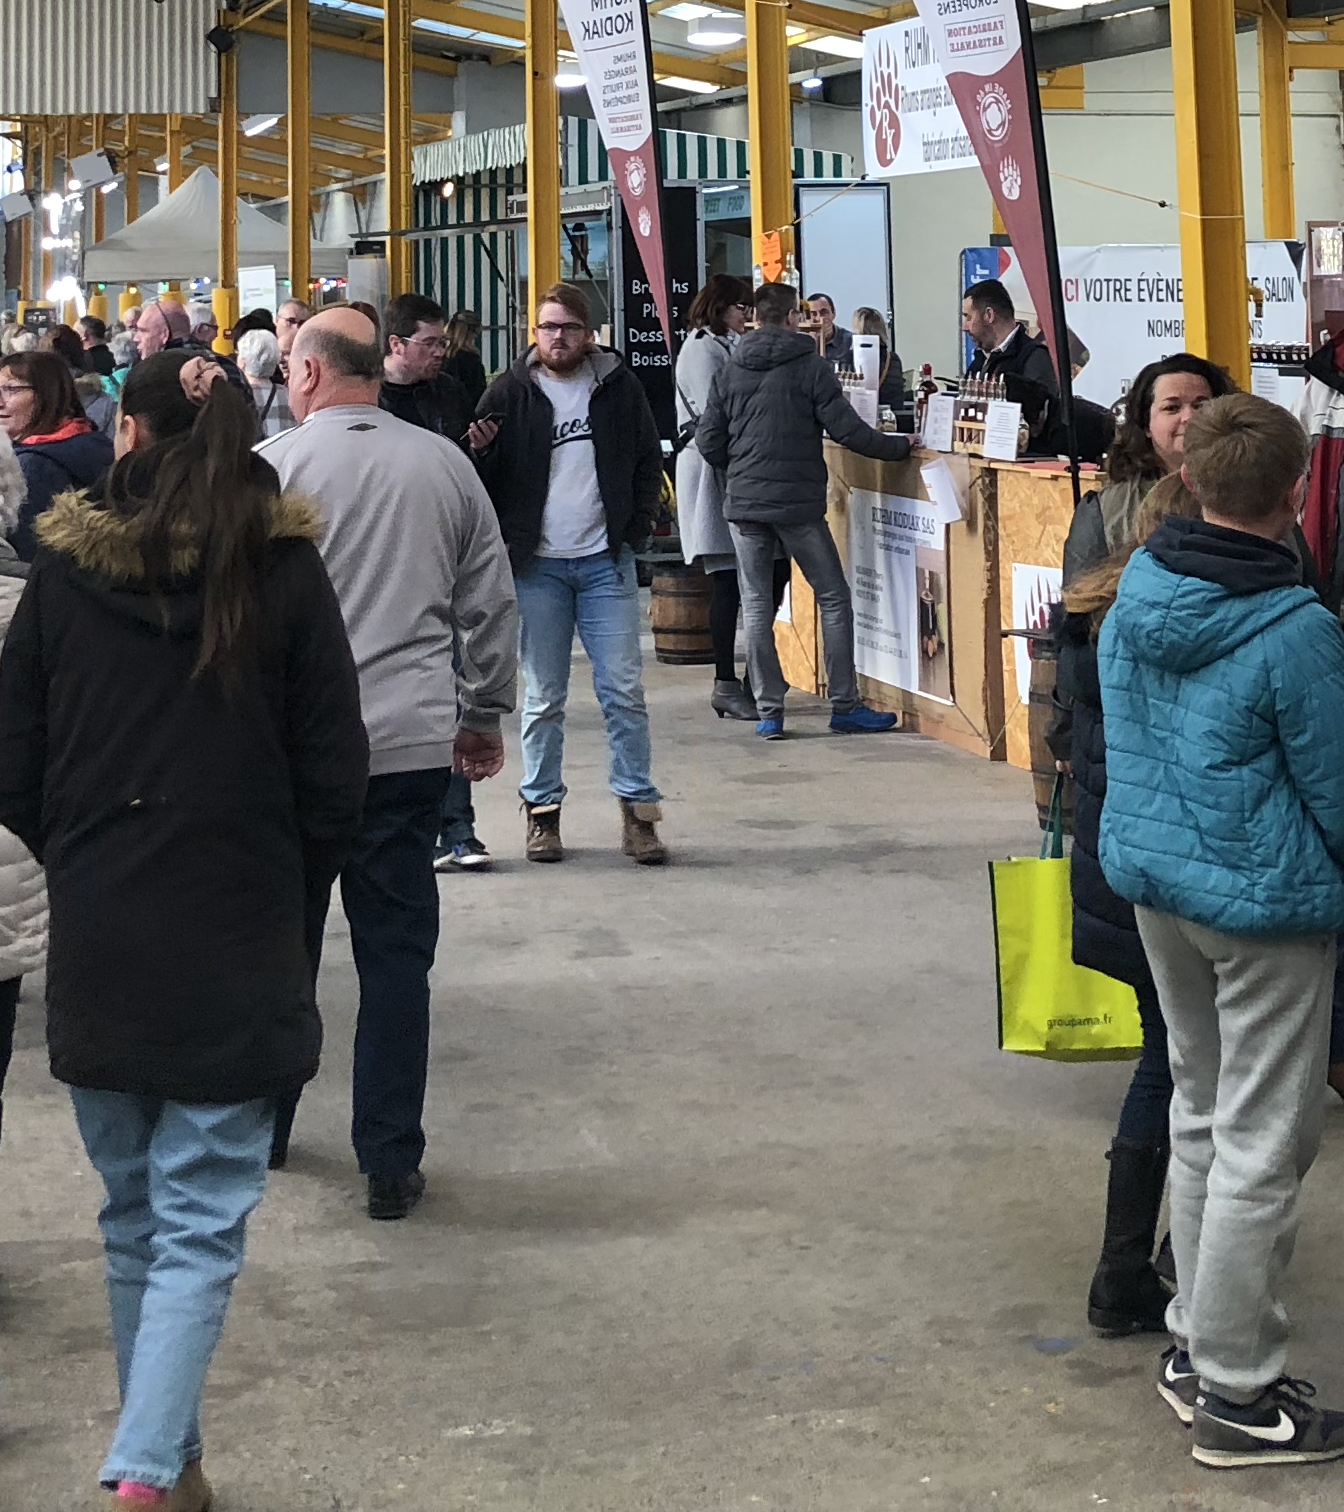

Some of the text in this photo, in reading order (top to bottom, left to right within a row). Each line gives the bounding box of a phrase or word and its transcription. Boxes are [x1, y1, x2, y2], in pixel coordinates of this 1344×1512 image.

[1084, 277, 1133, 303] VOTRE
[1137, 271, 1184, 303] ÉVÈNE
[1265, 276, 1295, 303] SALON
